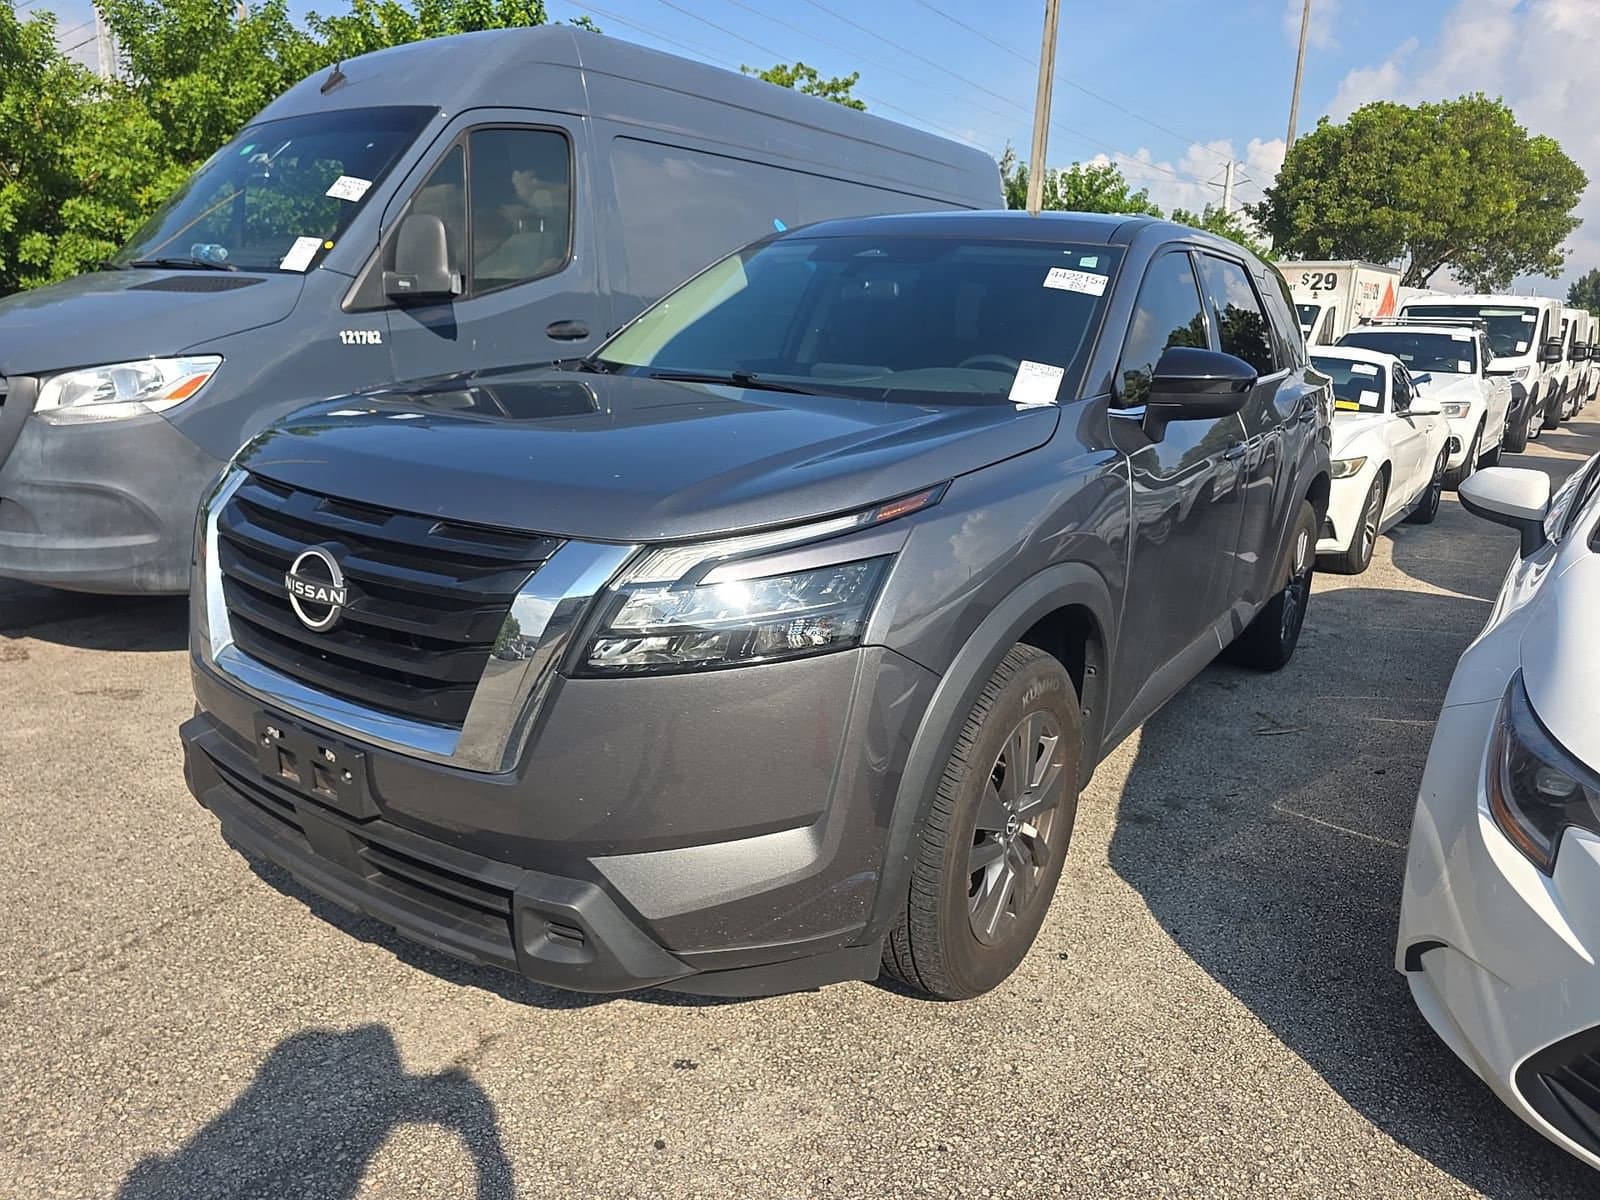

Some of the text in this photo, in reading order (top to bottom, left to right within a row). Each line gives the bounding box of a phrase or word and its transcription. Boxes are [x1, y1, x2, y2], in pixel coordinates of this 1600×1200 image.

[1051, 271, 1107, 286] 4422154
[1301, 272, 1338, 291] $29
[339, 330, 382, 345] 121782
[285, 575, 344, 604] NISSAN
